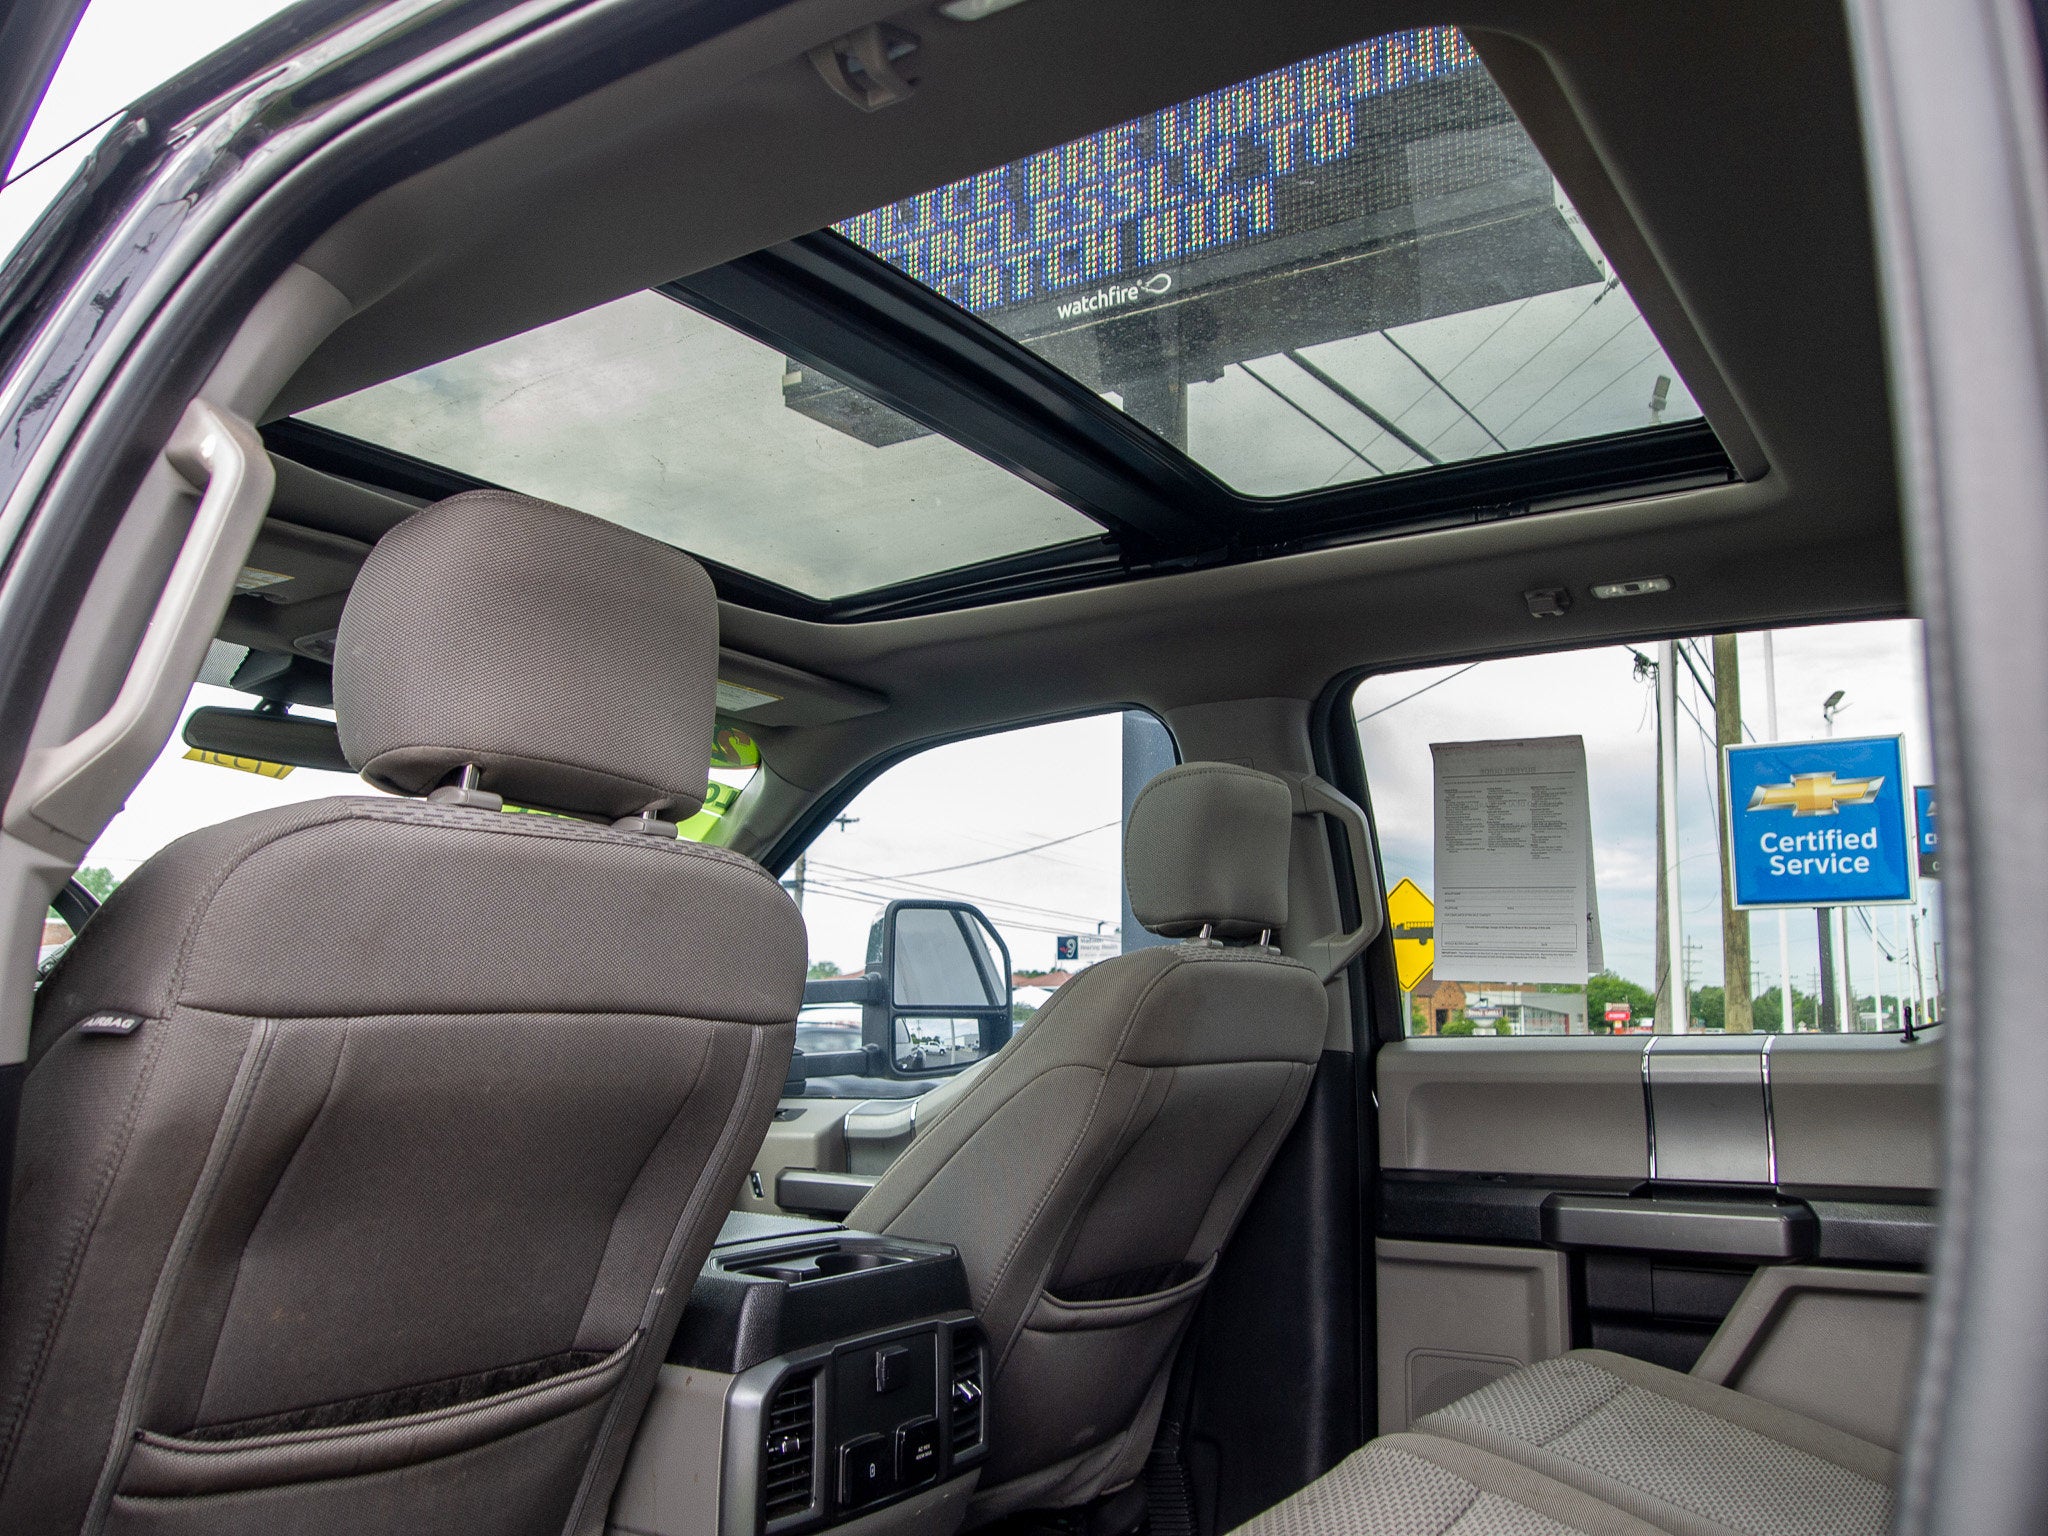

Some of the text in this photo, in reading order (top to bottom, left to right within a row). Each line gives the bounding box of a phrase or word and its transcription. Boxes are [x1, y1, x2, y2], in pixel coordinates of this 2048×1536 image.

[1260, 109, 1351, 174] TO
[1029, 125, 1137, 203] ARE
[1143, 183, 1273, 267] HIM
[1057, 283, 1139, 320] watchfire
[1760, 827, 1878, 854] Certified
[1770, 853, 1870, 876] Service
[83, 1015, 136, 1029] AIRBAG
